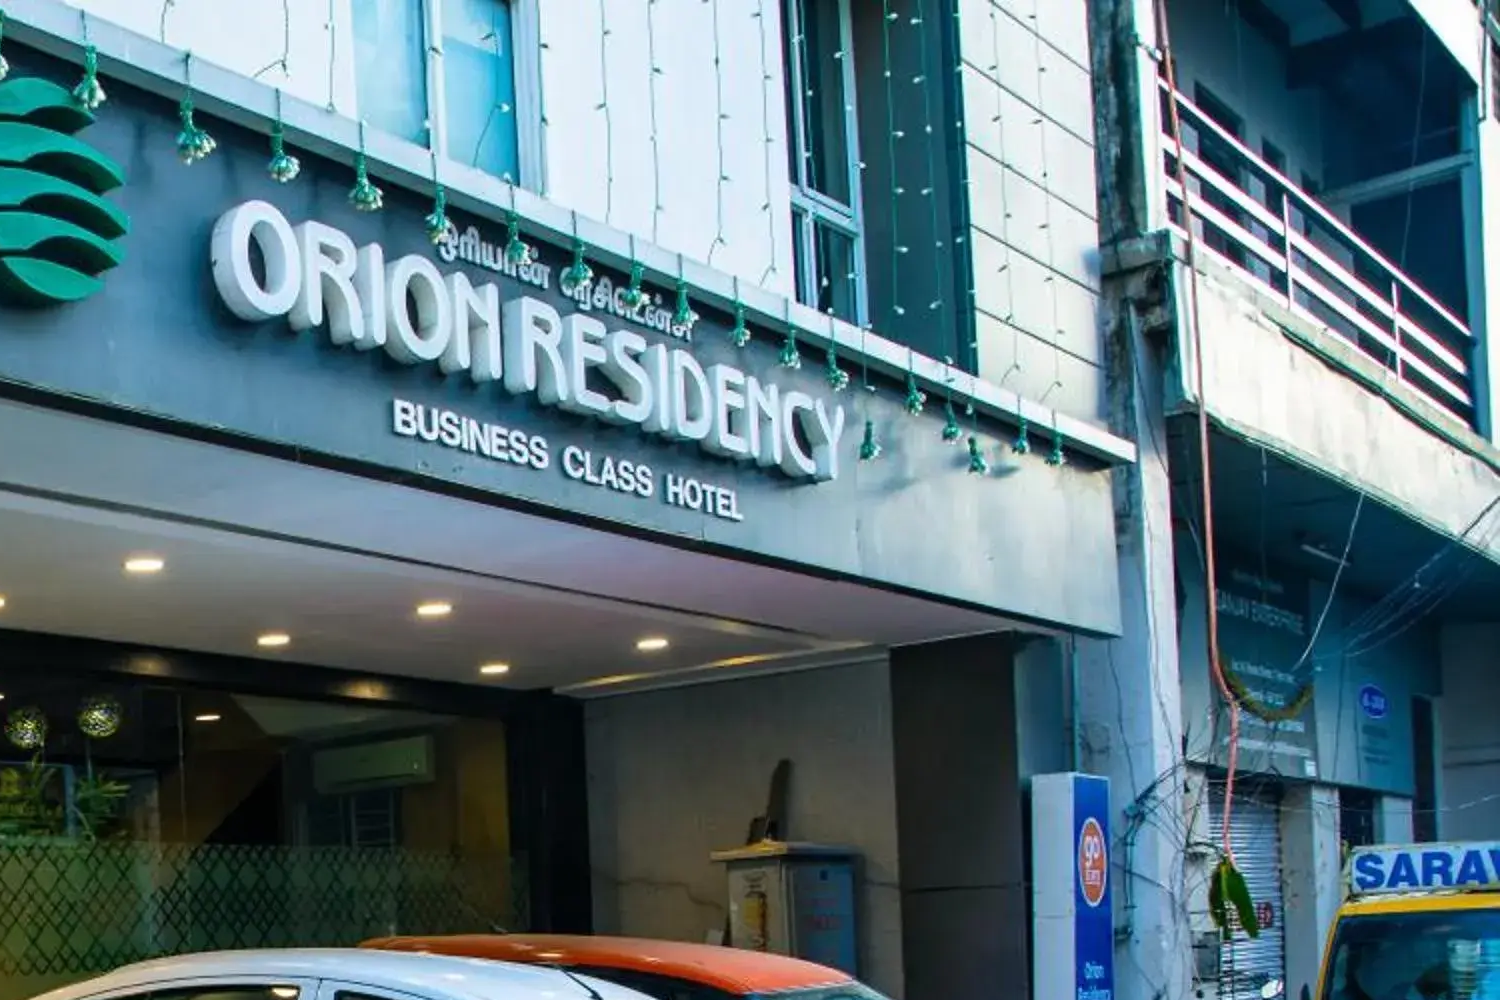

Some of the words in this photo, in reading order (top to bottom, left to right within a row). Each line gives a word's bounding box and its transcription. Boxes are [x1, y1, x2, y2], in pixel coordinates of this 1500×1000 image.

[211, 199, 502, 383] ORION
[503, 295, 845, 483] RESIDENCY
[393, 399, 550, 470] BUSINESS
[562, 446, 654, 498] CLASS
[666, 473, 744, 521] HOTEL
